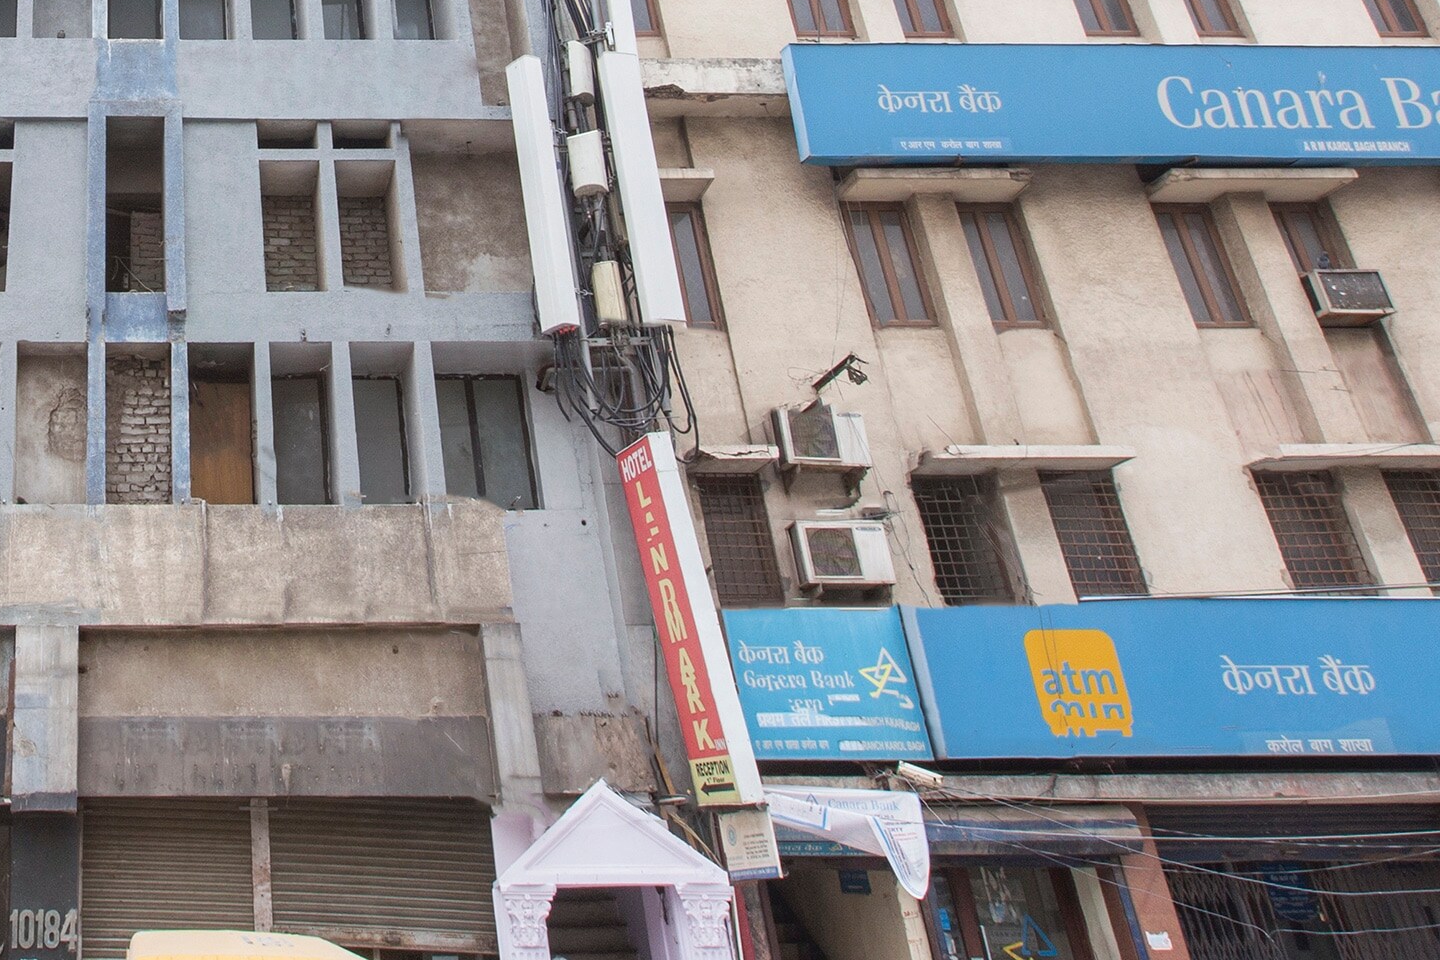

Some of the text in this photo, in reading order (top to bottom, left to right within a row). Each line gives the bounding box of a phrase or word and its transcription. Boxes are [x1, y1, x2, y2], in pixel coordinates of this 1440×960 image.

[877, 84, 1002, 113] केनरा बैंक
[1156, 76, 1440, 129] Canara B
[1326, 141, 1354, 151] KAROL
[1353, 141, 1377, 151] BAGH
[1376, 141, 1410, 151] BRANCH
[621, 445, 652, 483] HOTEL
[738, 640, 791, 665] केनरा
[1041, 661, 1119, 695] atm
[1219, 654, 1376, 695] केनरा बैंक
[1265, 734, 1374, 753] करोल बाग शाखा
[695, 760, 730, 777] RECEPTION
[827, 799, 900, 812] Canara Bank
[10, 908, 78, 952] 10184
